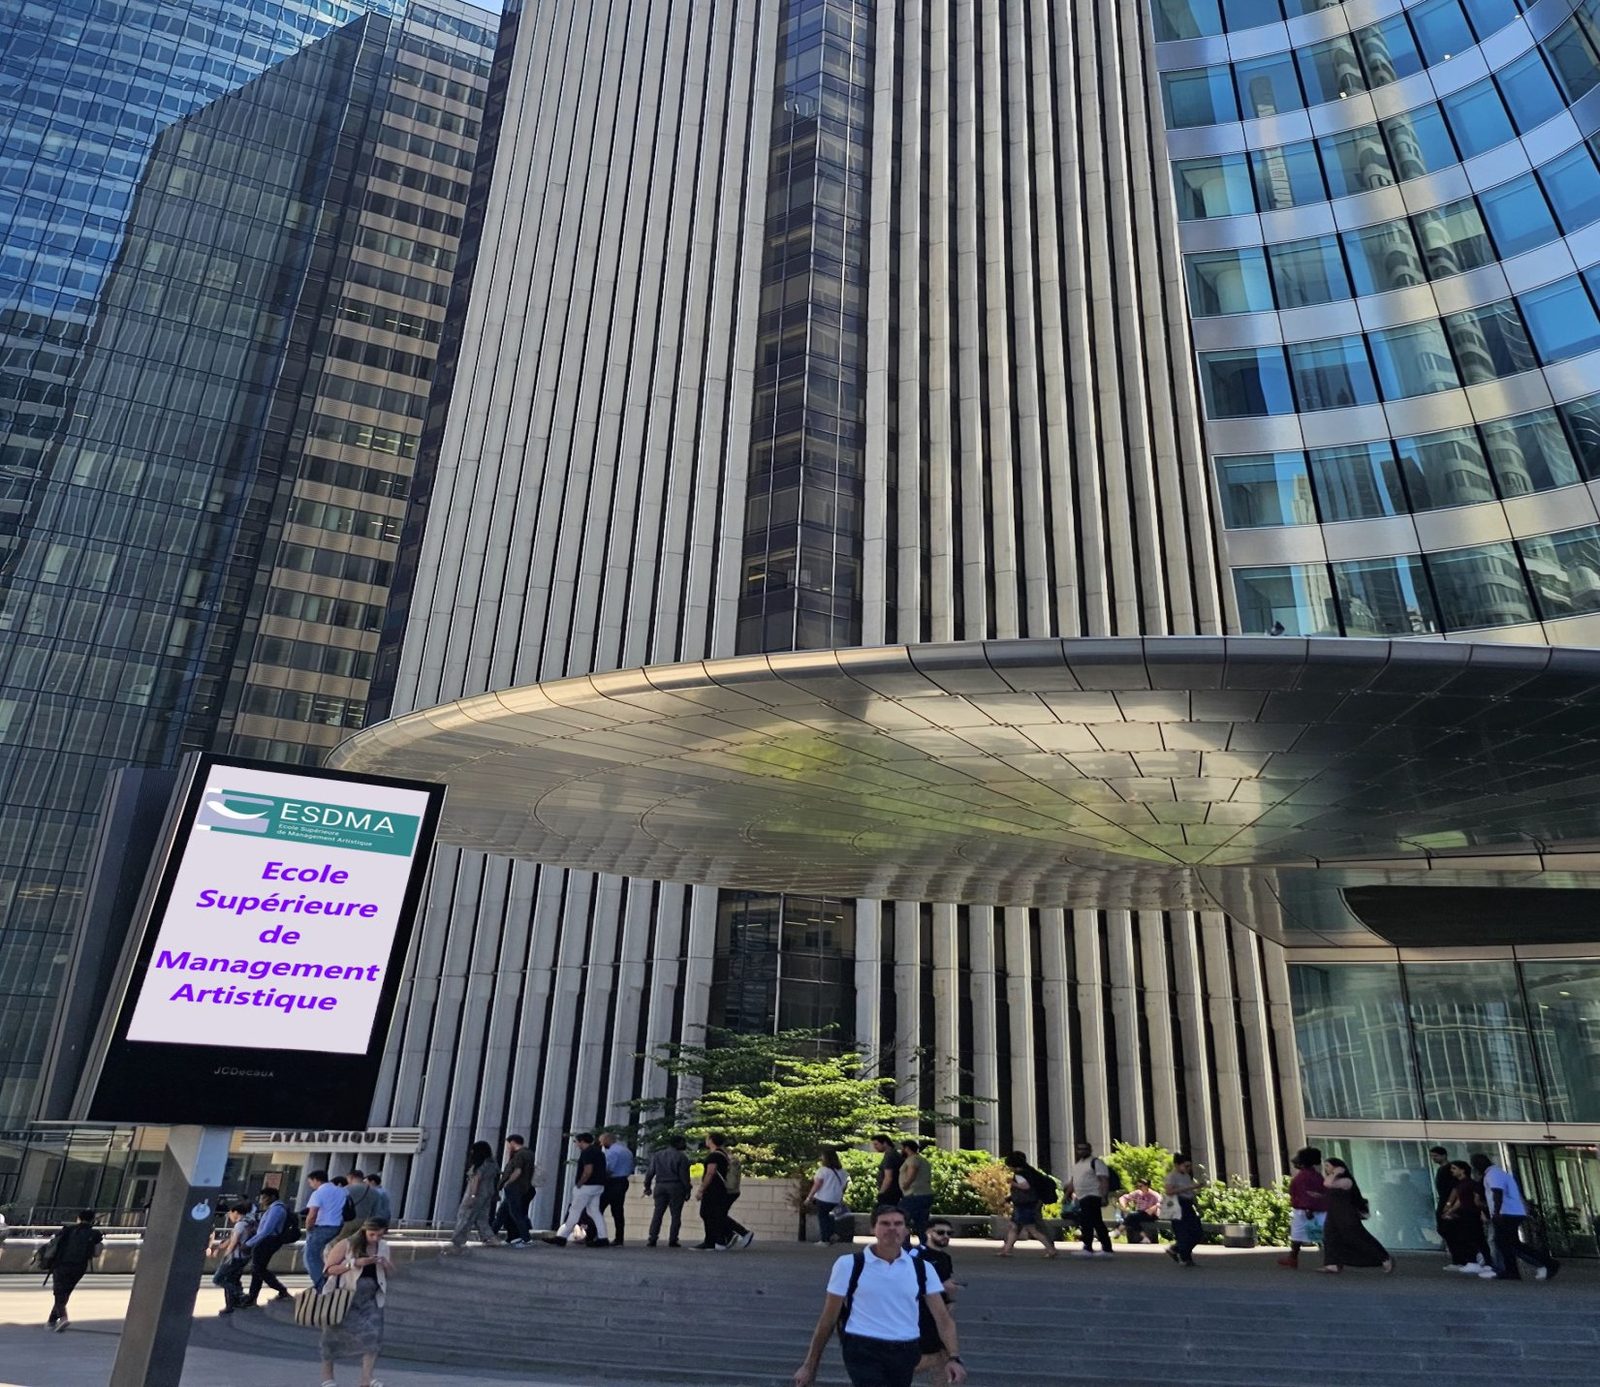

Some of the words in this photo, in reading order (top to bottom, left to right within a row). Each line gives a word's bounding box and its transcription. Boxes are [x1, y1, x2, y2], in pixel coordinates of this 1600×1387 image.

[278, 823, 299, 831] Ecole
[280, 803, 395, 834] ESDMA
[287, 831, 335, 841] Management
[336, 837, 373, 847] Artistique
[261, 860, 350, 884] Ecole
[196, 889, 379, 918] Supérieure
[258, 924, 301, 945] de
[156, 950, 381, 982] Management
[170, 983, 338, 1014] Artistique
[271, 1131, 390, 1144] ATLANTIQUE
